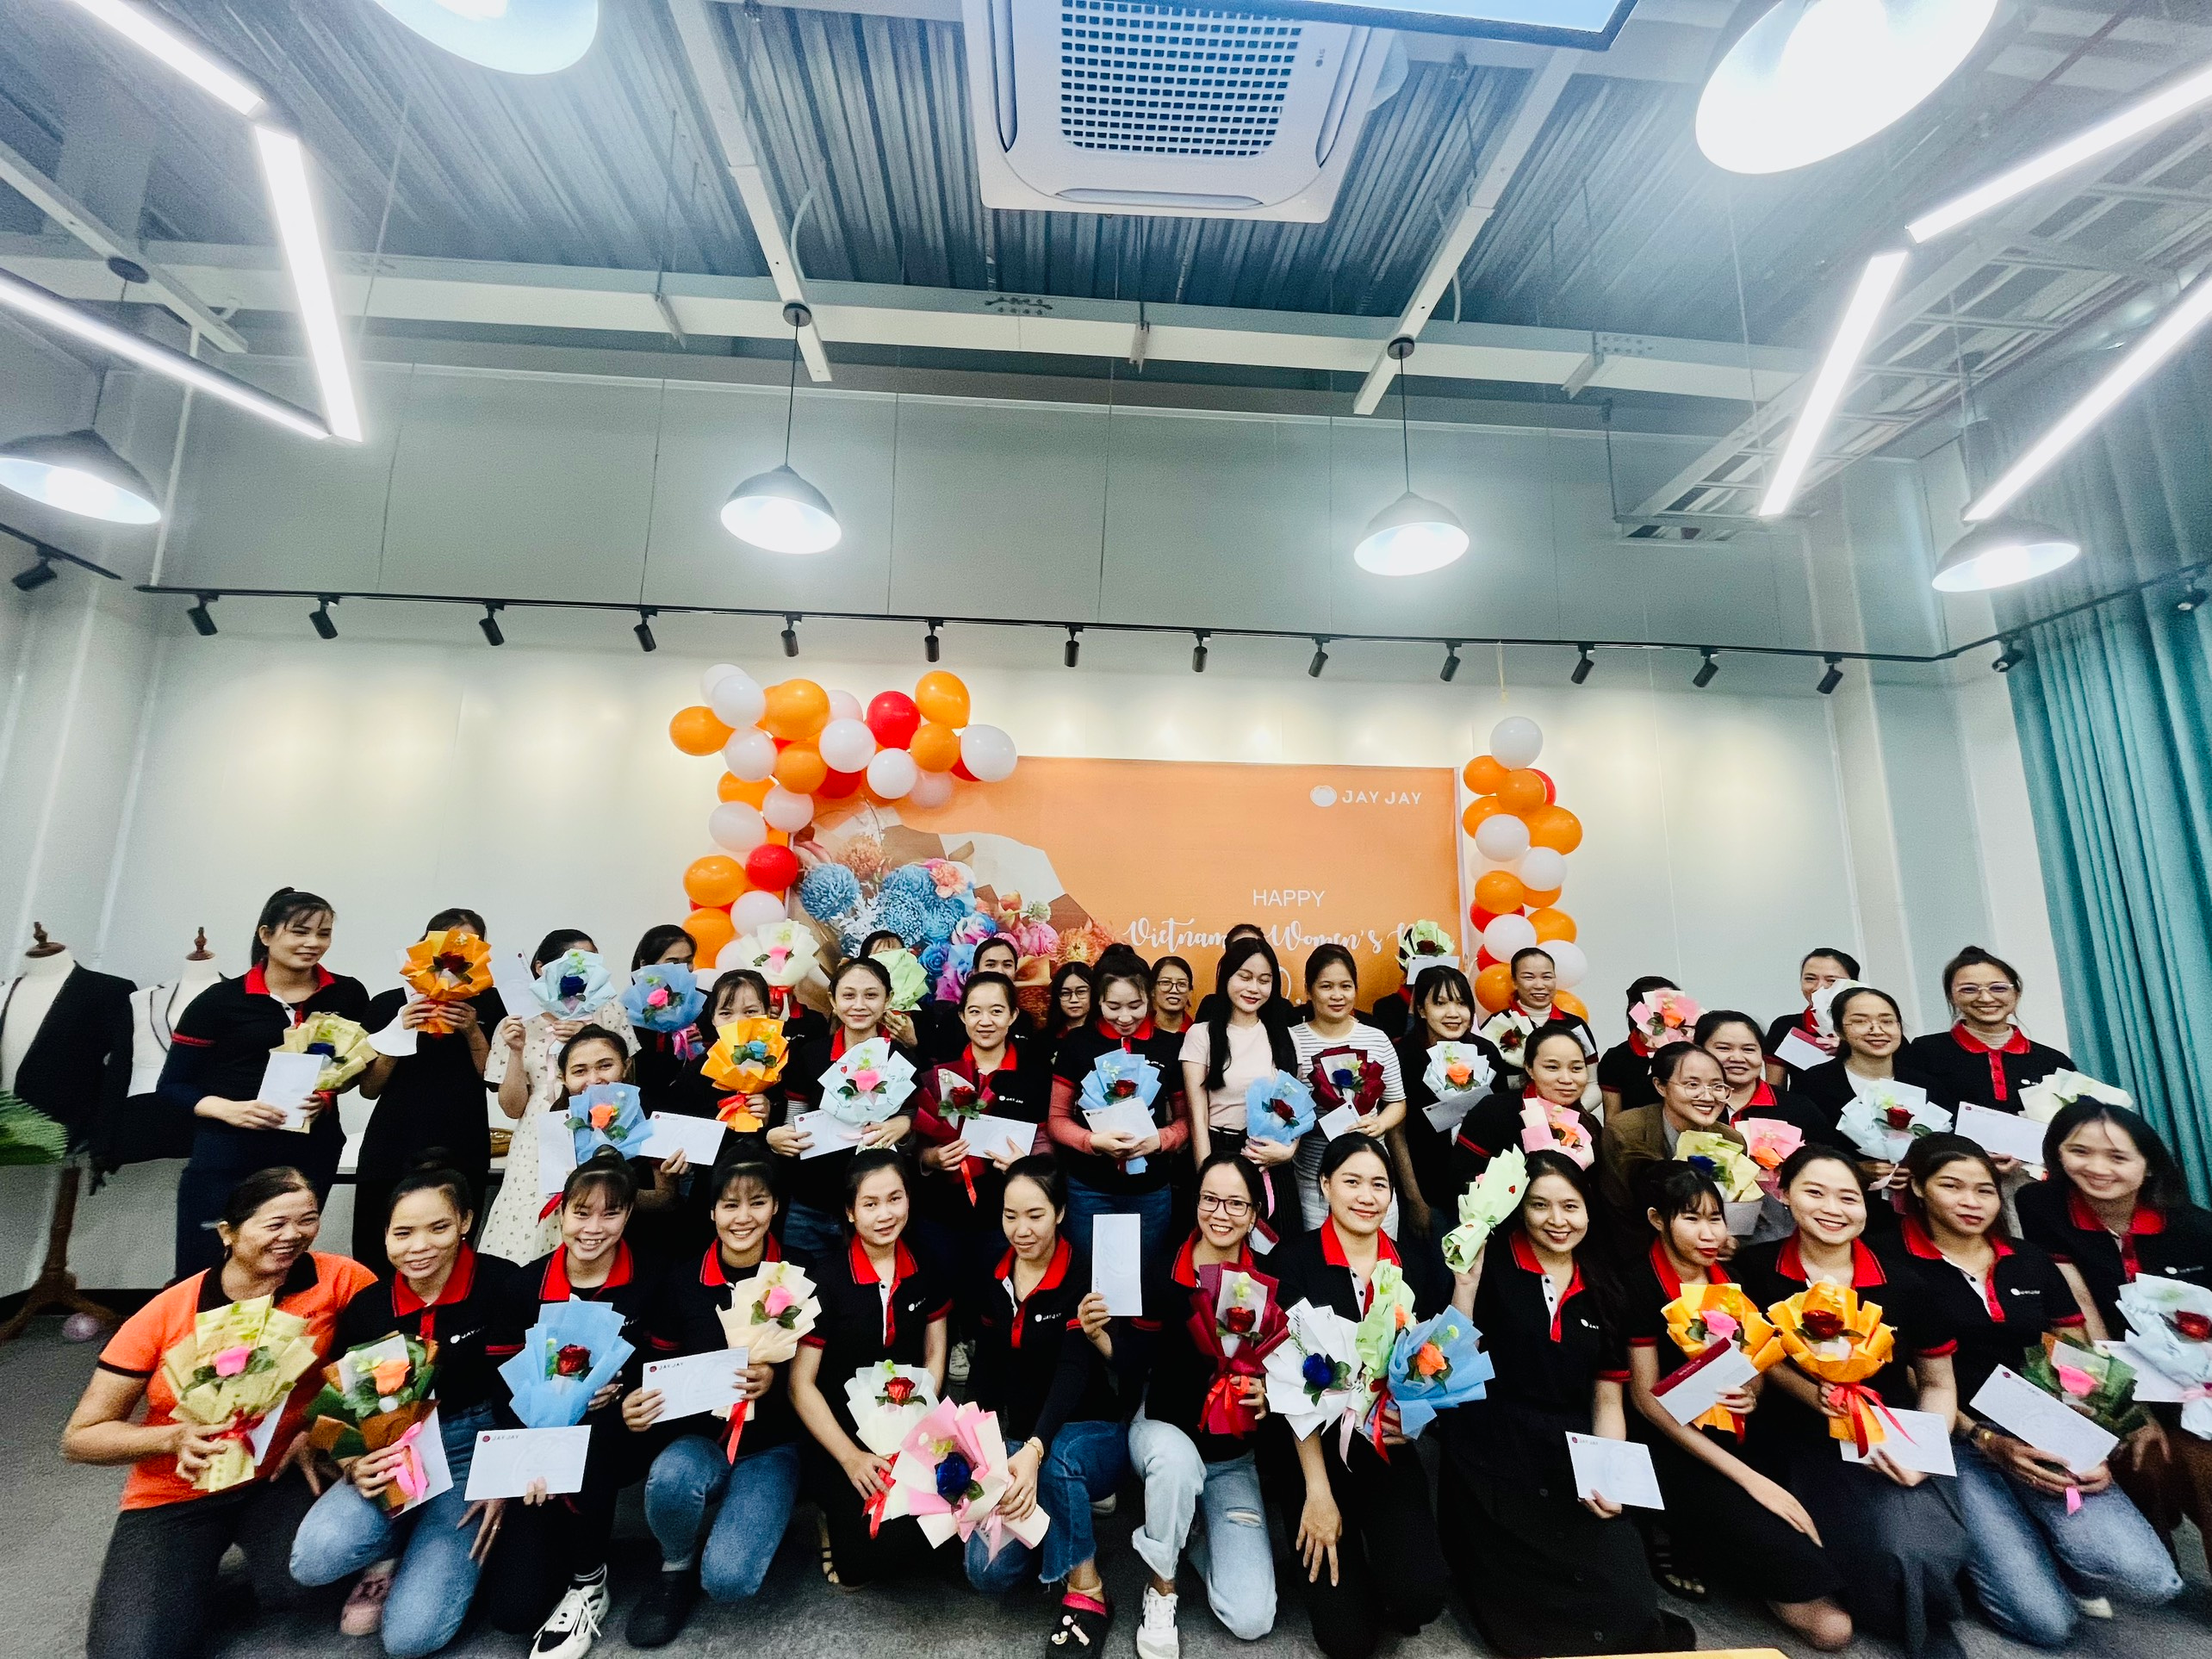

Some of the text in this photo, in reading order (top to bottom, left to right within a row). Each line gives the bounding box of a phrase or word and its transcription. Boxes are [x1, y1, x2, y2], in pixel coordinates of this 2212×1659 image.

[1341, 790, 1422, 805] JAY JAY
[1253, 889, 1326, 908] HAPPY
[1122, 916, 1226, 954] Vietnam
[461, 1330, 475, 1339] JAY
